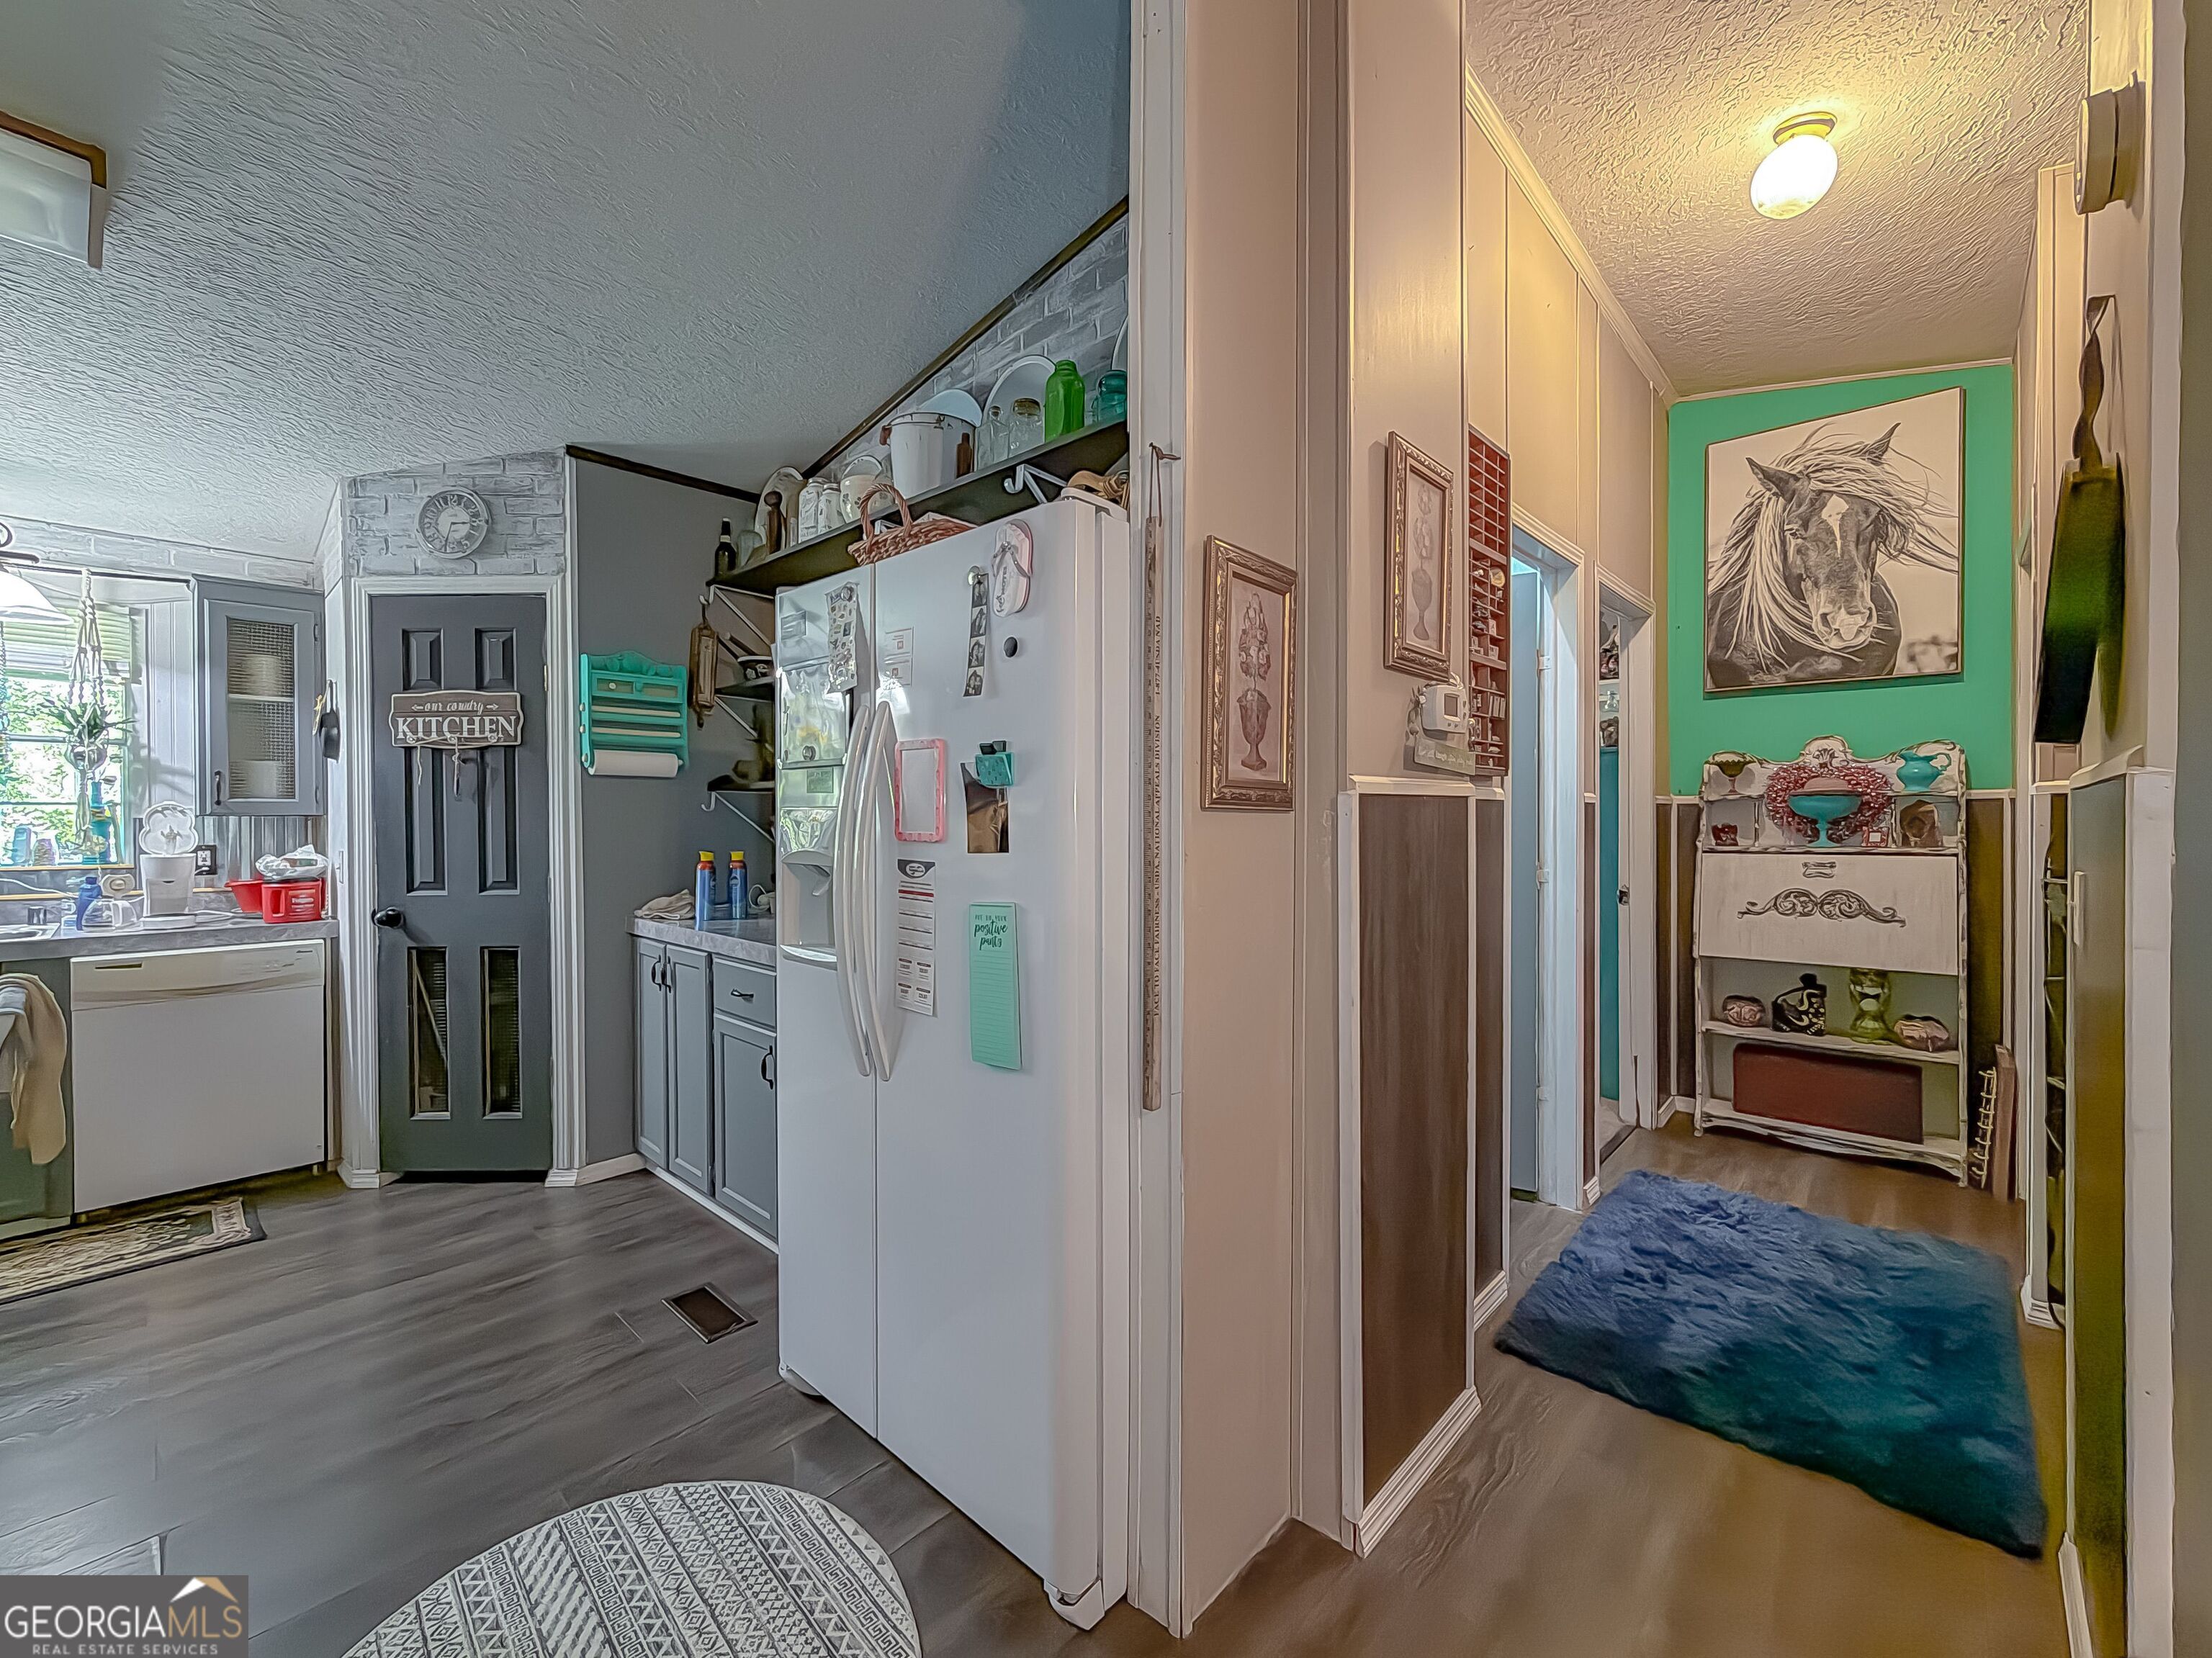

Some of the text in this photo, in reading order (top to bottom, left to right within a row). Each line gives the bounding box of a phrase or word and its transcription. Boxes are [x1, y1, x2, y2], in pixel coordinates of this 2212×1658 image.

[424, 699, 485, 714] our country
[396, 716, 517, 739] KITCHEN
[974, 919, 1007, 937] positive
[1154, 975, 1160, 989] TO
